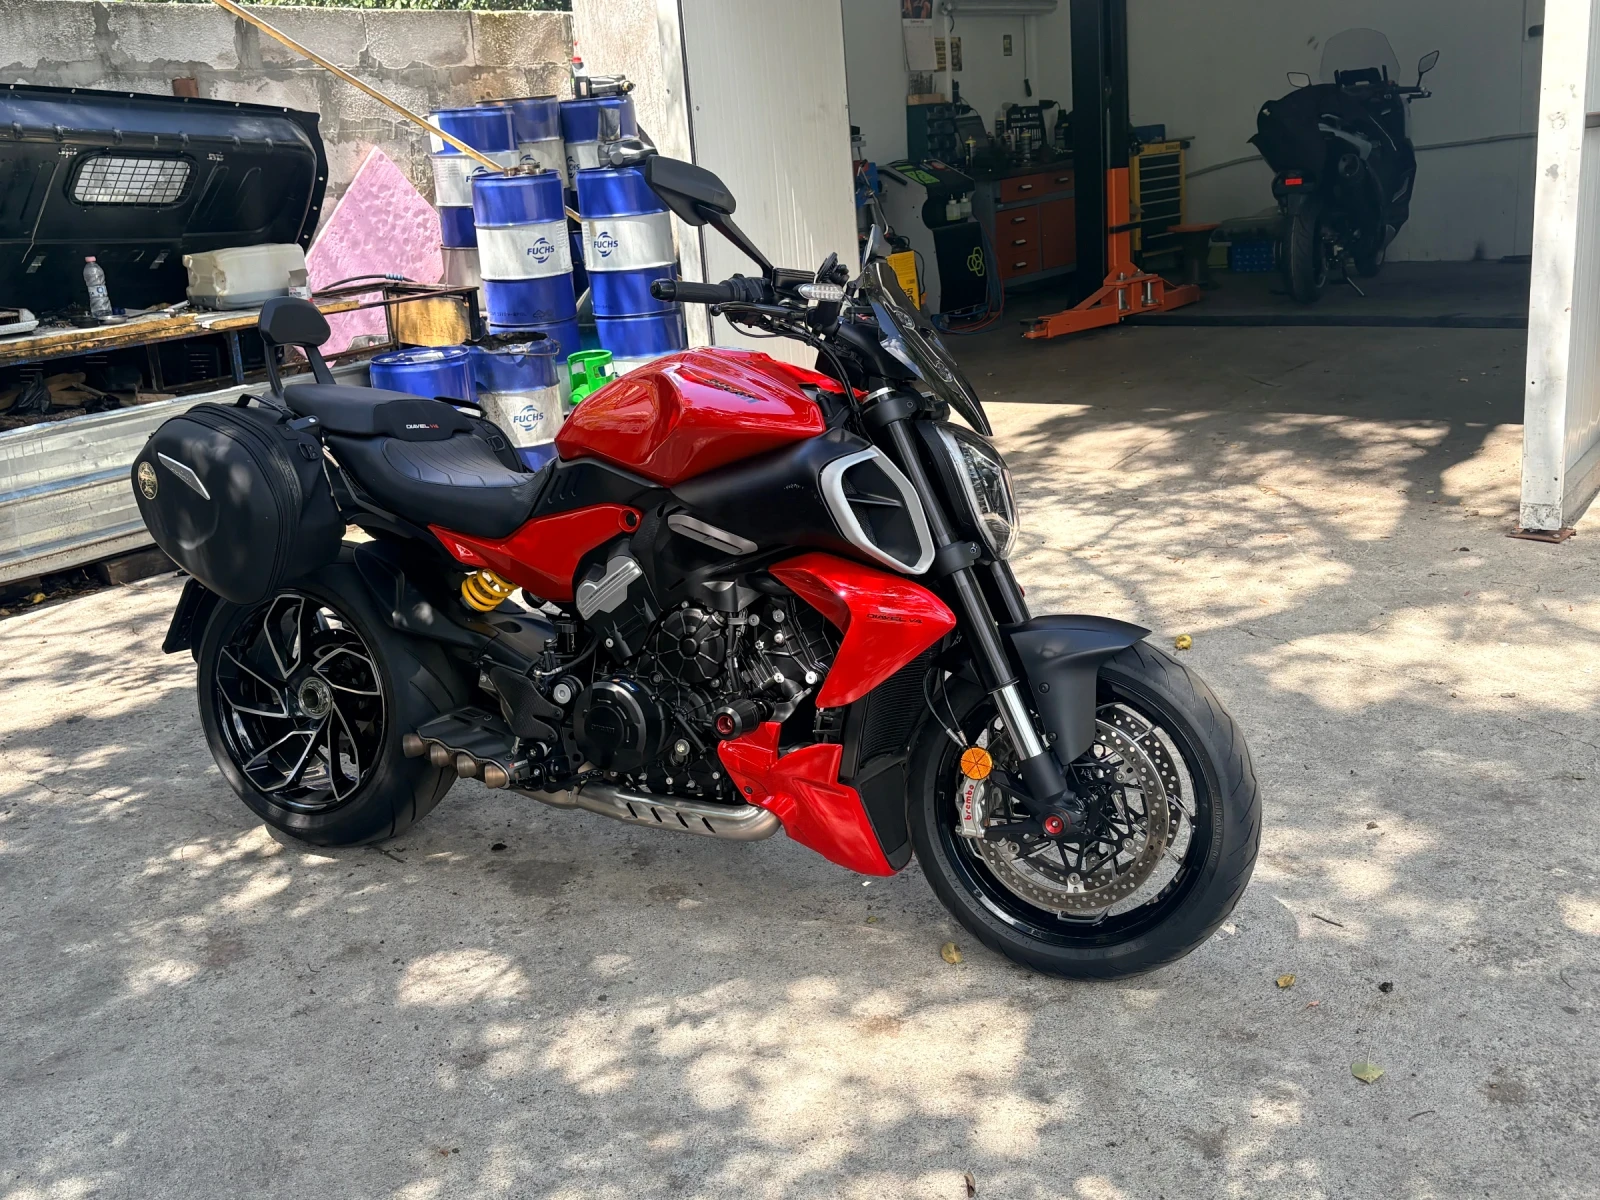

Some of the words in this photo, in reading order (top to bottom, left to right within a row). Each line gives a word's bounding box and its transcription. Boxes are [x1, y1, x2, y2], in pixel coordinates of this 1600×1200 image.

[593, 240, 619, 249] FUCHS
[527, 245, 555, 256] FUCHS
[513, 412, 544, 423] FUCHS
[867, 613, 905, 621] DIAVEL
[964, 784, 975, 820] brembo
